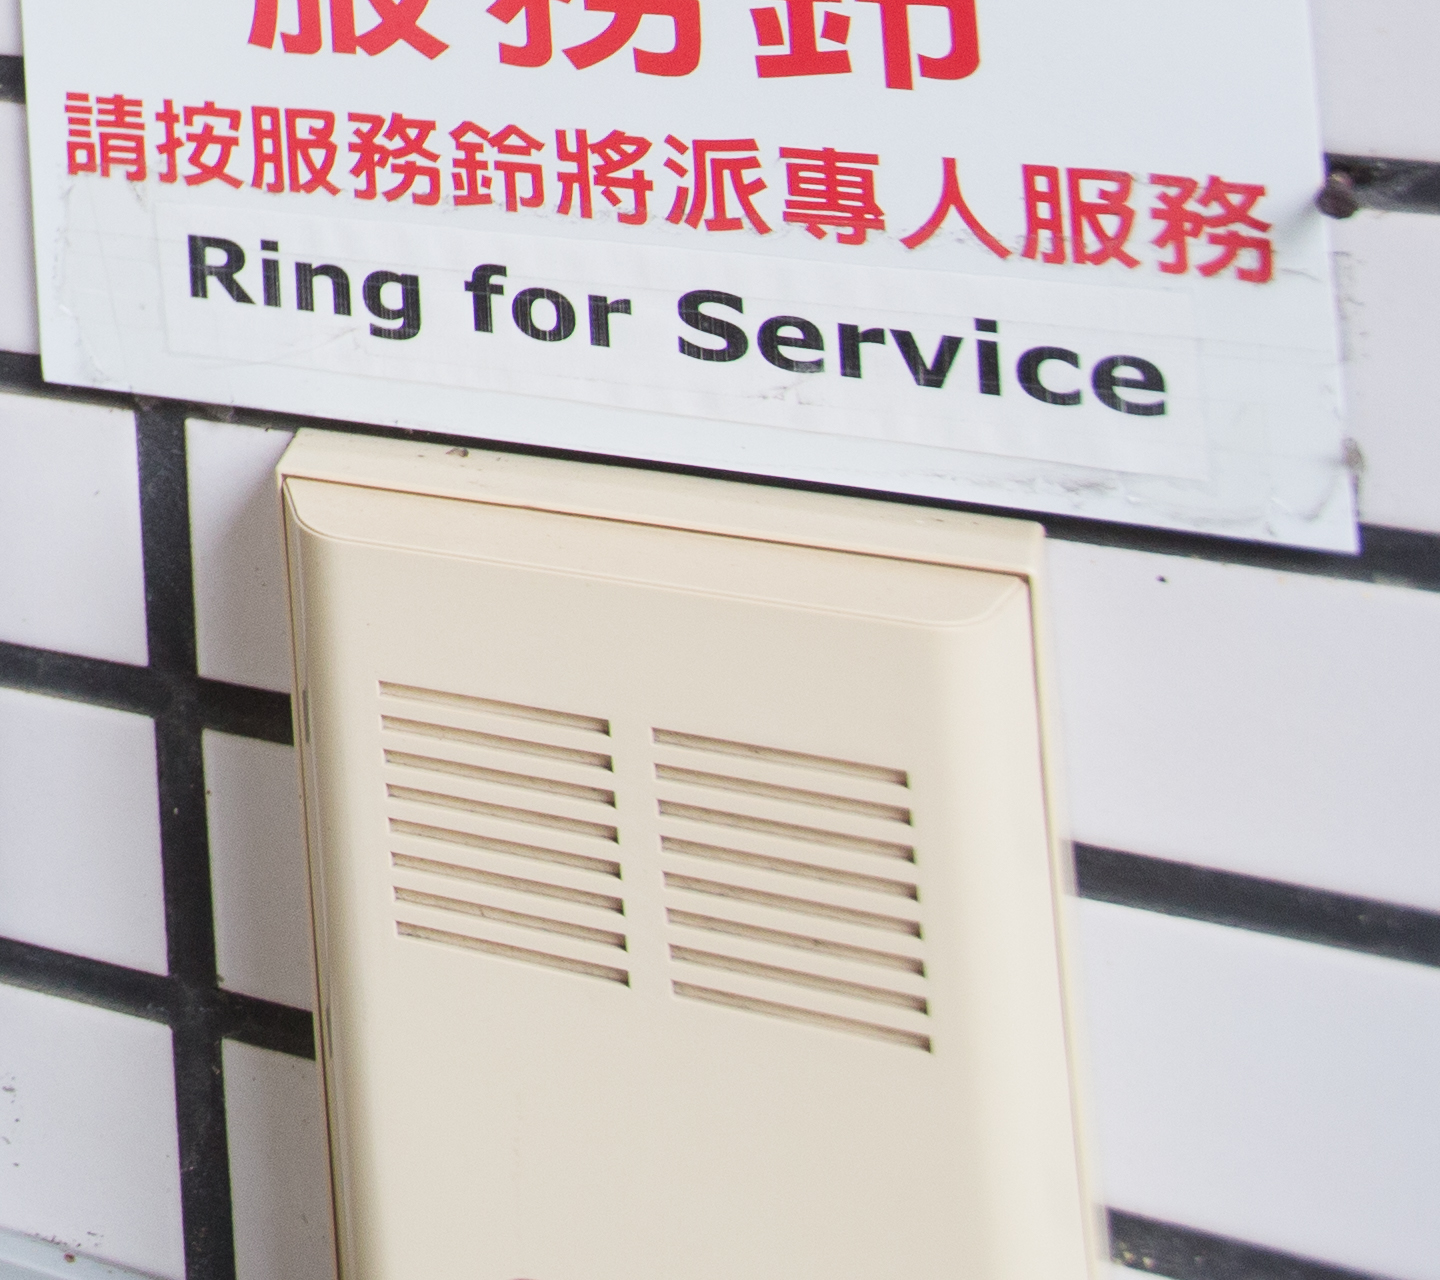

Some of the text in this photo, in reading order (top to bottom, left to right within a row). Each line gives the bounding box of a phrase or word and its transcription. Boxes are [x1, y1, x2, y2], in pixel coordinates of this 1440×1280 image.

[62, 90, 1279, 287] 請按服務鈴將派專人服務
[186, 232, 1171, 418] Ring for Service
